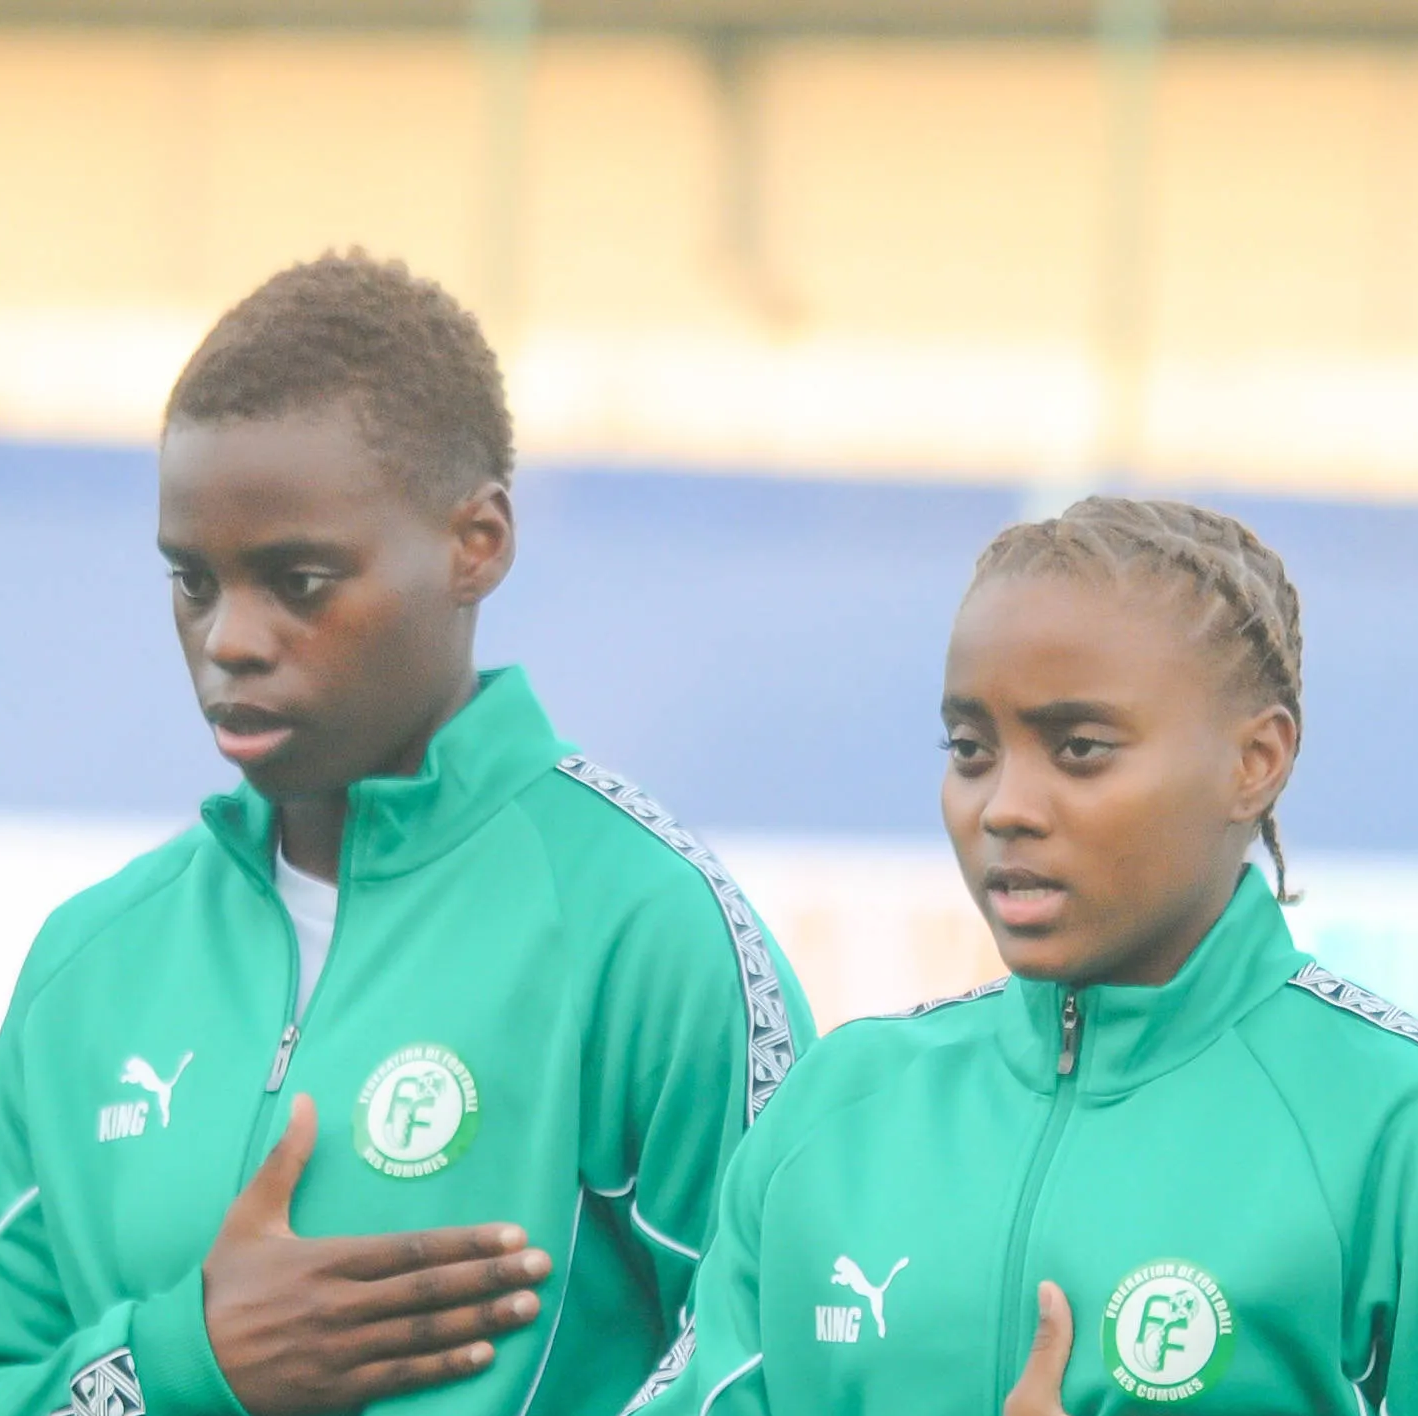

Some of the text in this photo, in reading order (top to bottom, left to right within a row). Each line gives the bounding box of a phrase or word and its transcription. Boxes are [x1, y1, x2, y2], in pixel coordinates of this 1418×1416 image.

[99, 1101, 149, 1142] KING
[1178, 1265, 1196, 1278] DE
[816, 1305, 862, 1343] KING
[1112, 1366, 1204, 1401] DES COMORES
